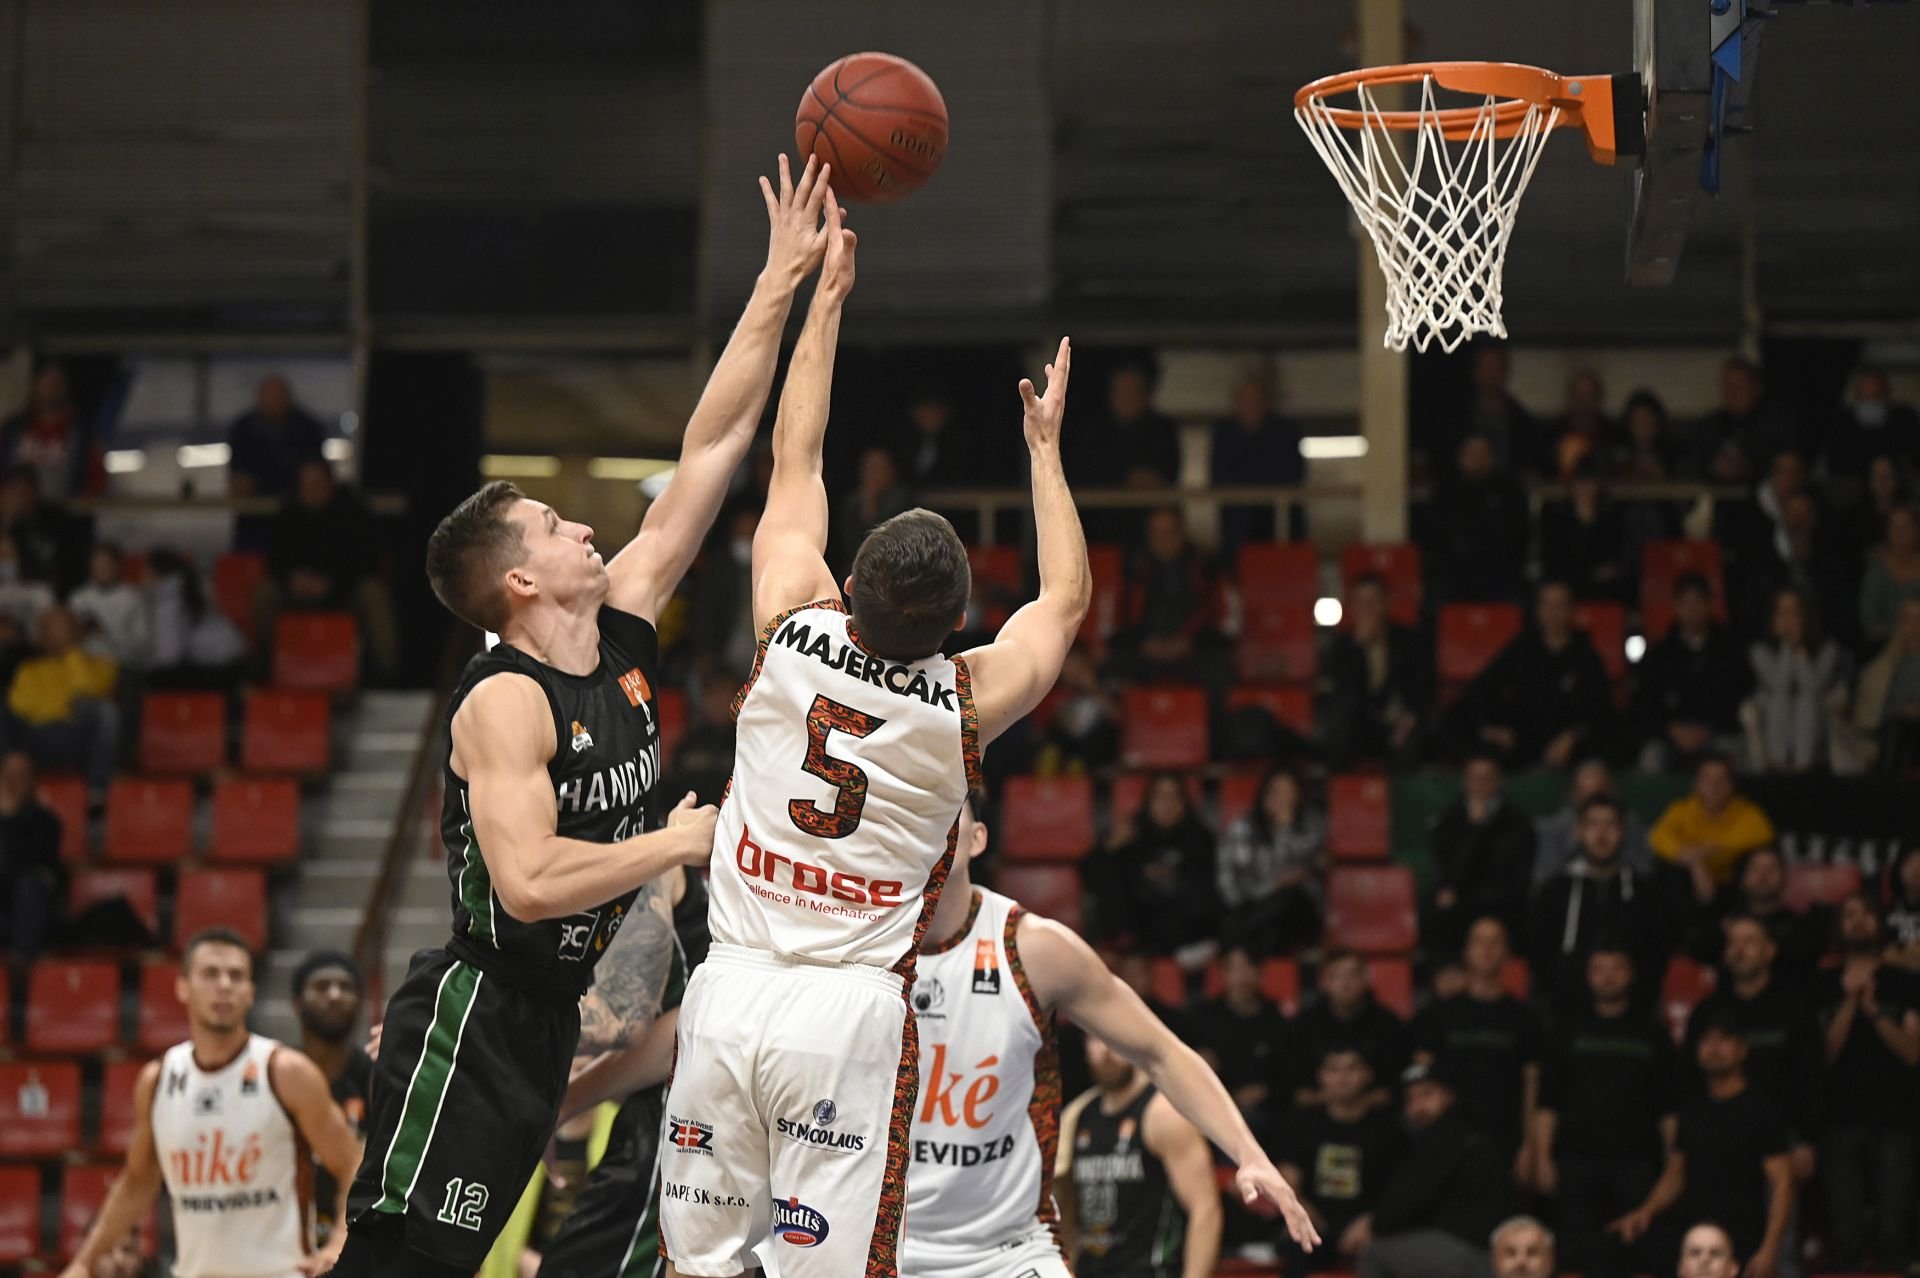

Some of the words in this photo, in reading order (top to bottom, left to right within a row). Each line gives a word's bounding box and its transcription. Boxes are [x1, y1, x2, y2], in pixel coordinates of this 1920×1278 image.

[557, 735, 660, 812] HANDOV
[787, 693, 887, 839] 5
[736, 822, 904, 908] brose
[795, 895, 807, 908] in
[911, 1134, 1015, 1166] EVIDZA
[437, 1177, 489, 1231] 12
[665, 1182, 691, 1202] DAPE
[693, 1188, 710, 1204] SK
[714, 1195, 750, 1208] s.r.o.
